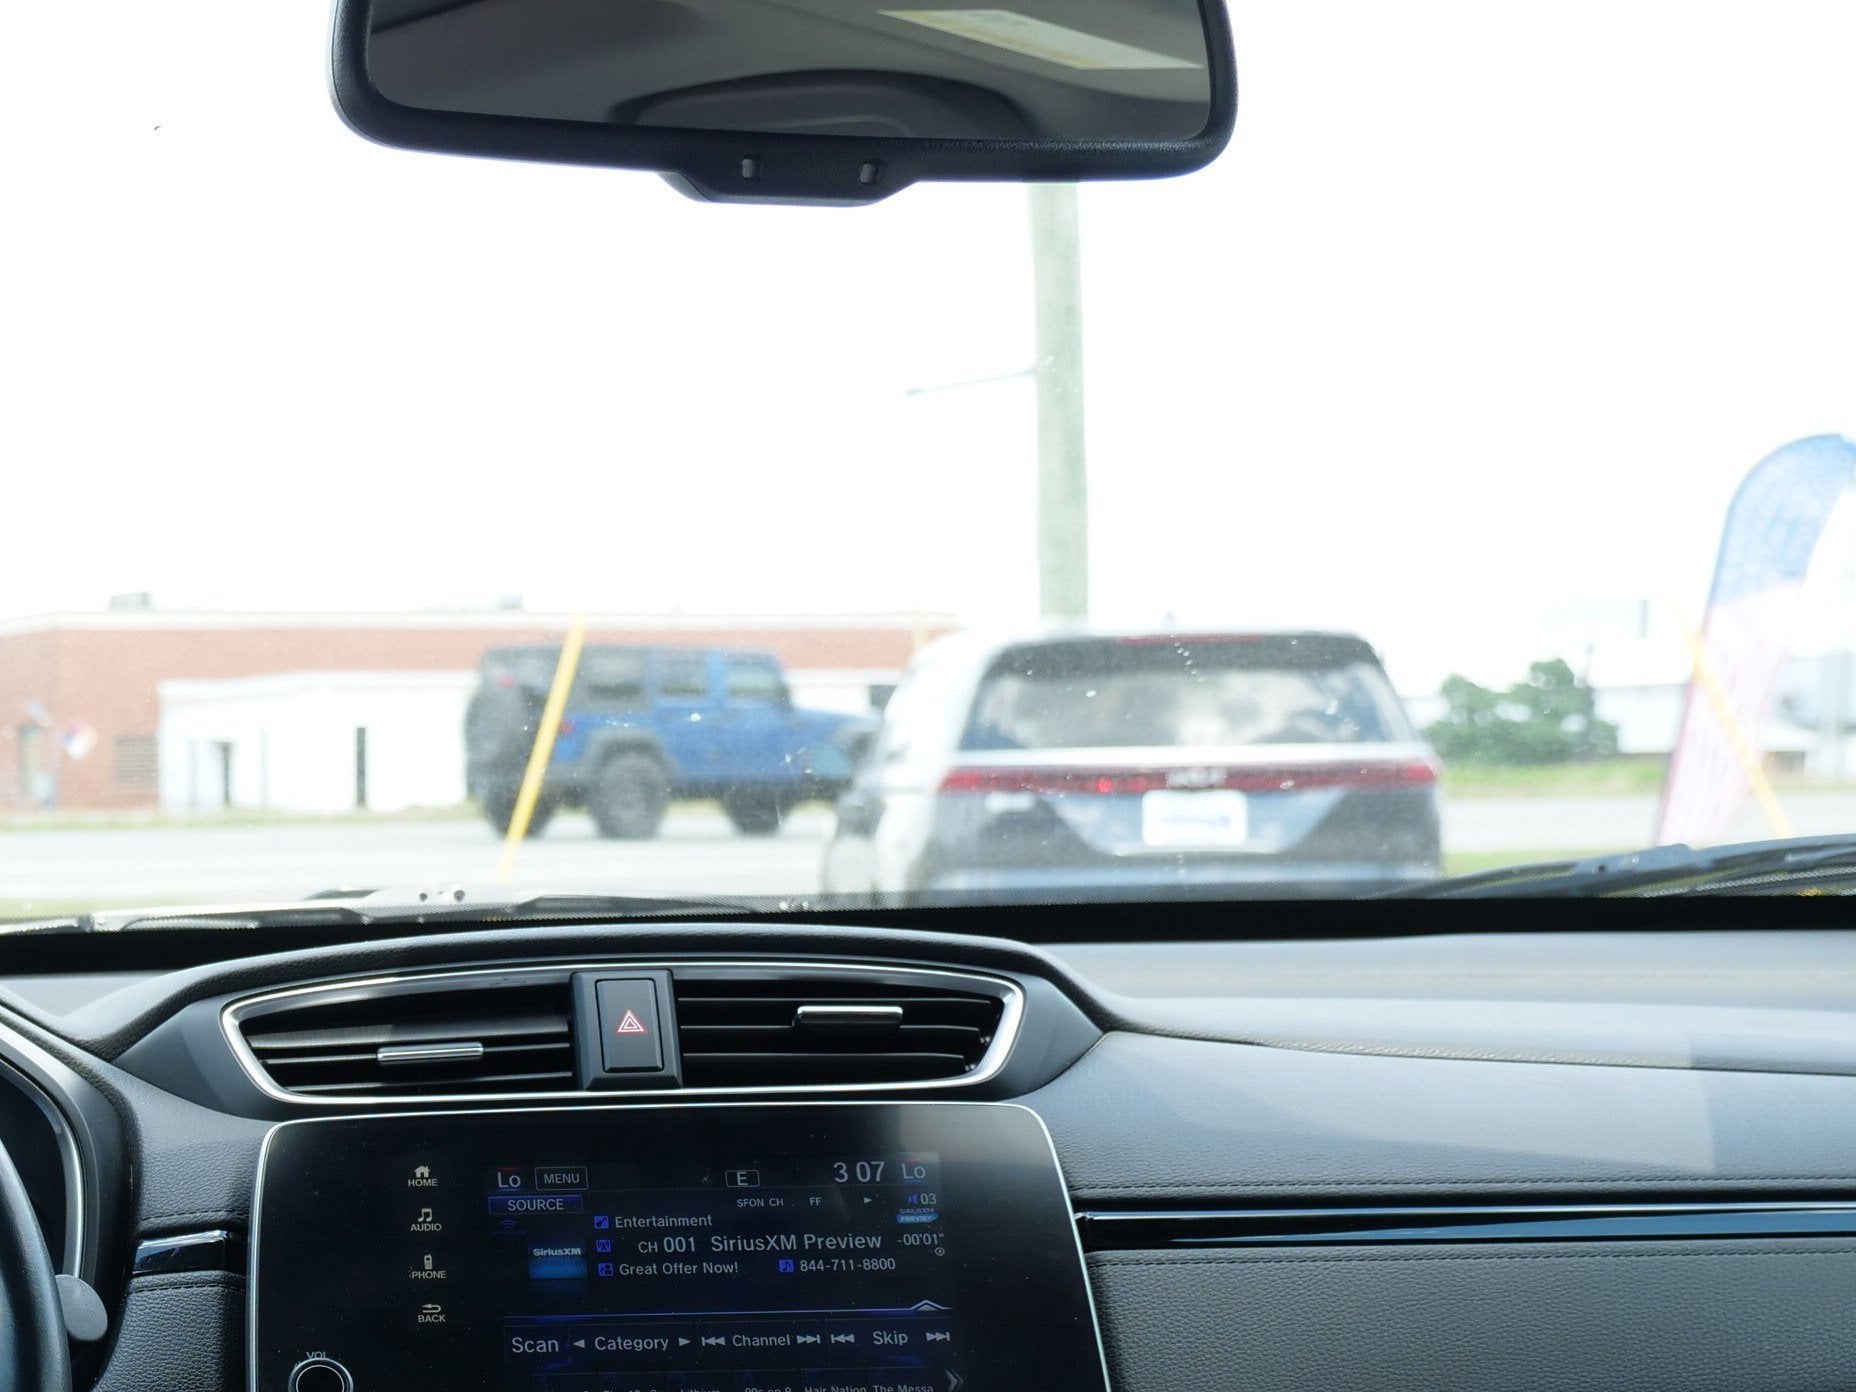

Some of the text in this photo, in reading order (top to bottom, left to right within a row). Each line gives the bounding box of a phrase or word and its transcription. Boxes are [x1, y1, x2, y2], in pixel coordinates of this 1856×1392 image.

[407, 1178, 439, 1188] HOME
[543, 1173, 580, 1185] MENU
[507, 1198, 565, 1211] SOURCE
[769, 1197, 784, 1207] CH
[809, 1196, 822, 1206] FF
[920, 1193, 937, 1205] 03
[410, 1222, 443, 1232] AUDIO
[615, 1214, 714, 1229] Entertainment
[638, 1233, 882, 1254] CH 001 SiriusXM Preview
[532, 1247, 582, 1257] SiriusXM
[619, 1261, 739, 1275] Great Offer Now!
[799, 1258, 896, 1272] 844-711-8800
[411, 1269, 447, 1279] PHONE
[417, 1314, 446, 1323] BACK
[594, 1336, 670, 1351] Category
[732, 1333, 791, 1347] Channel
[872, 1330, 909, 1346] Skip
[511, 1337, 560, 1353] Scan
